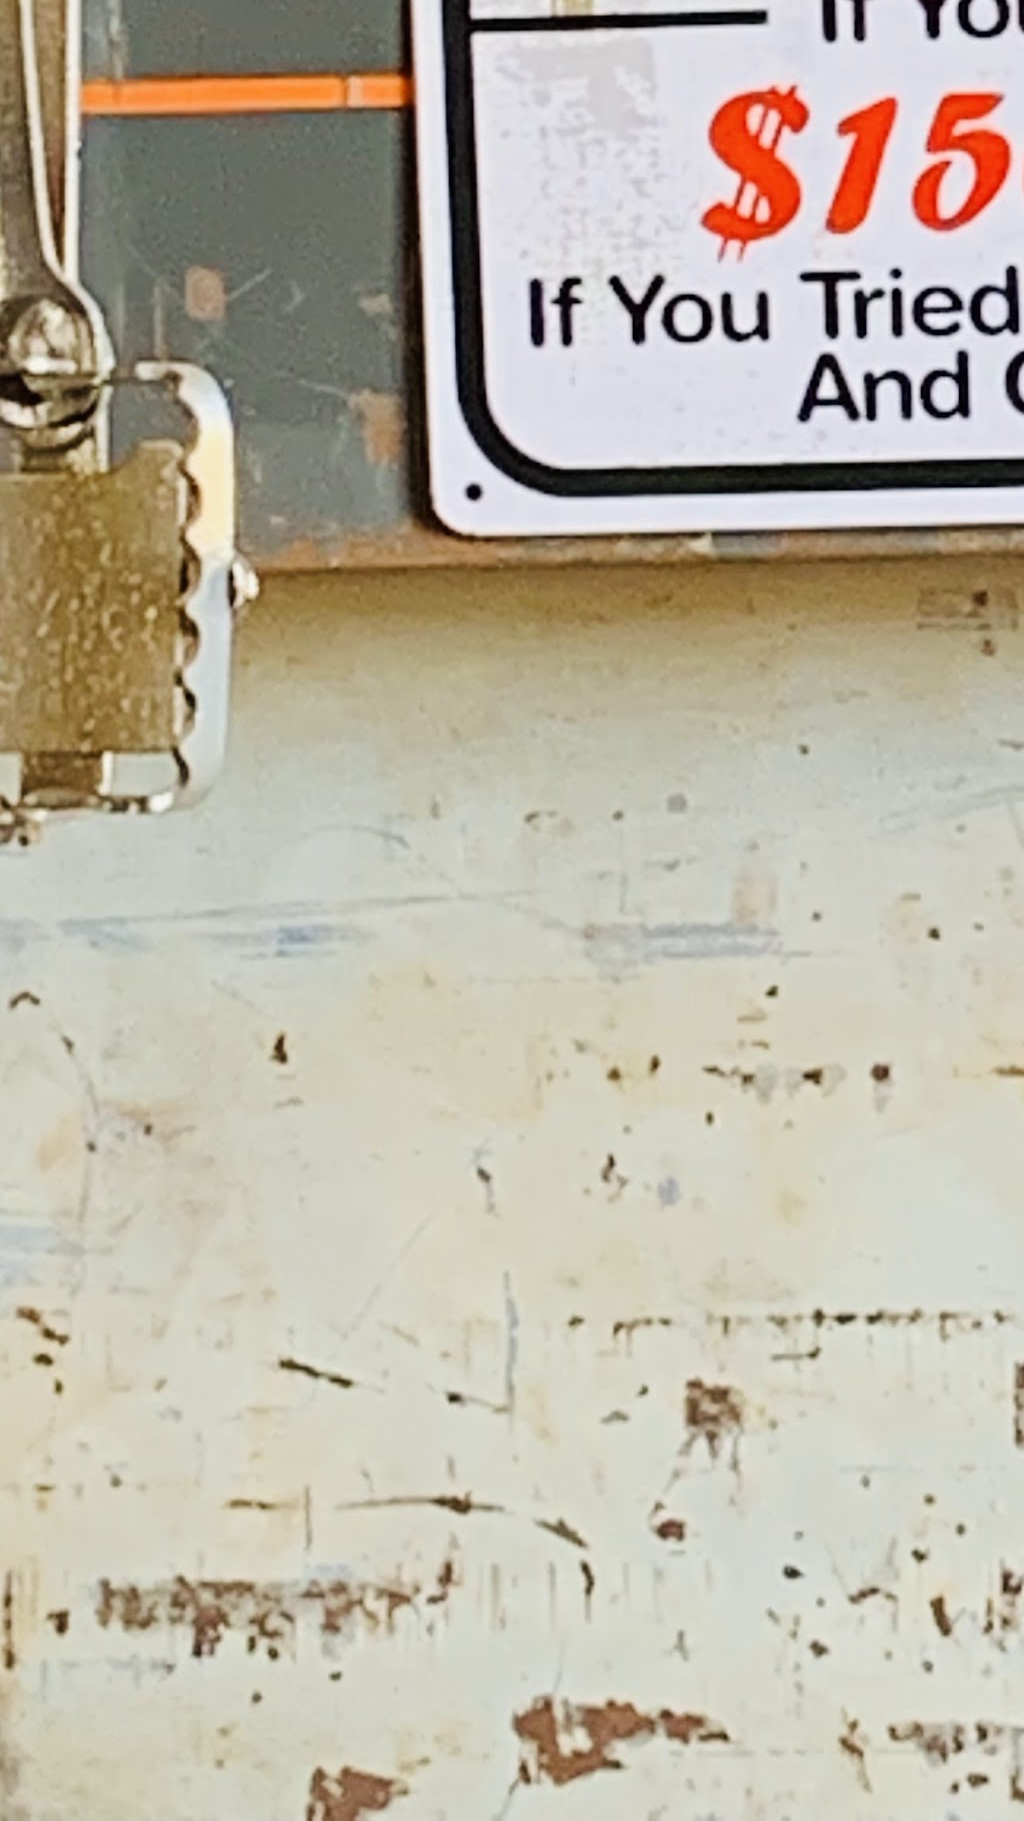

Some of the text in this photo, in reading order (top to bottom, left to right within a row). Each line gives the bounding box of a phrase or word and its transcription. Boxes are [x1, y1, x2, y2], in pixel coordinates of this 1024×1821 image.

[529, 276, 582, 347] If
[608, 274, 770, 345] You
[799, 265, 1020, 340] Tried
[797, 350, 970, 423] And
